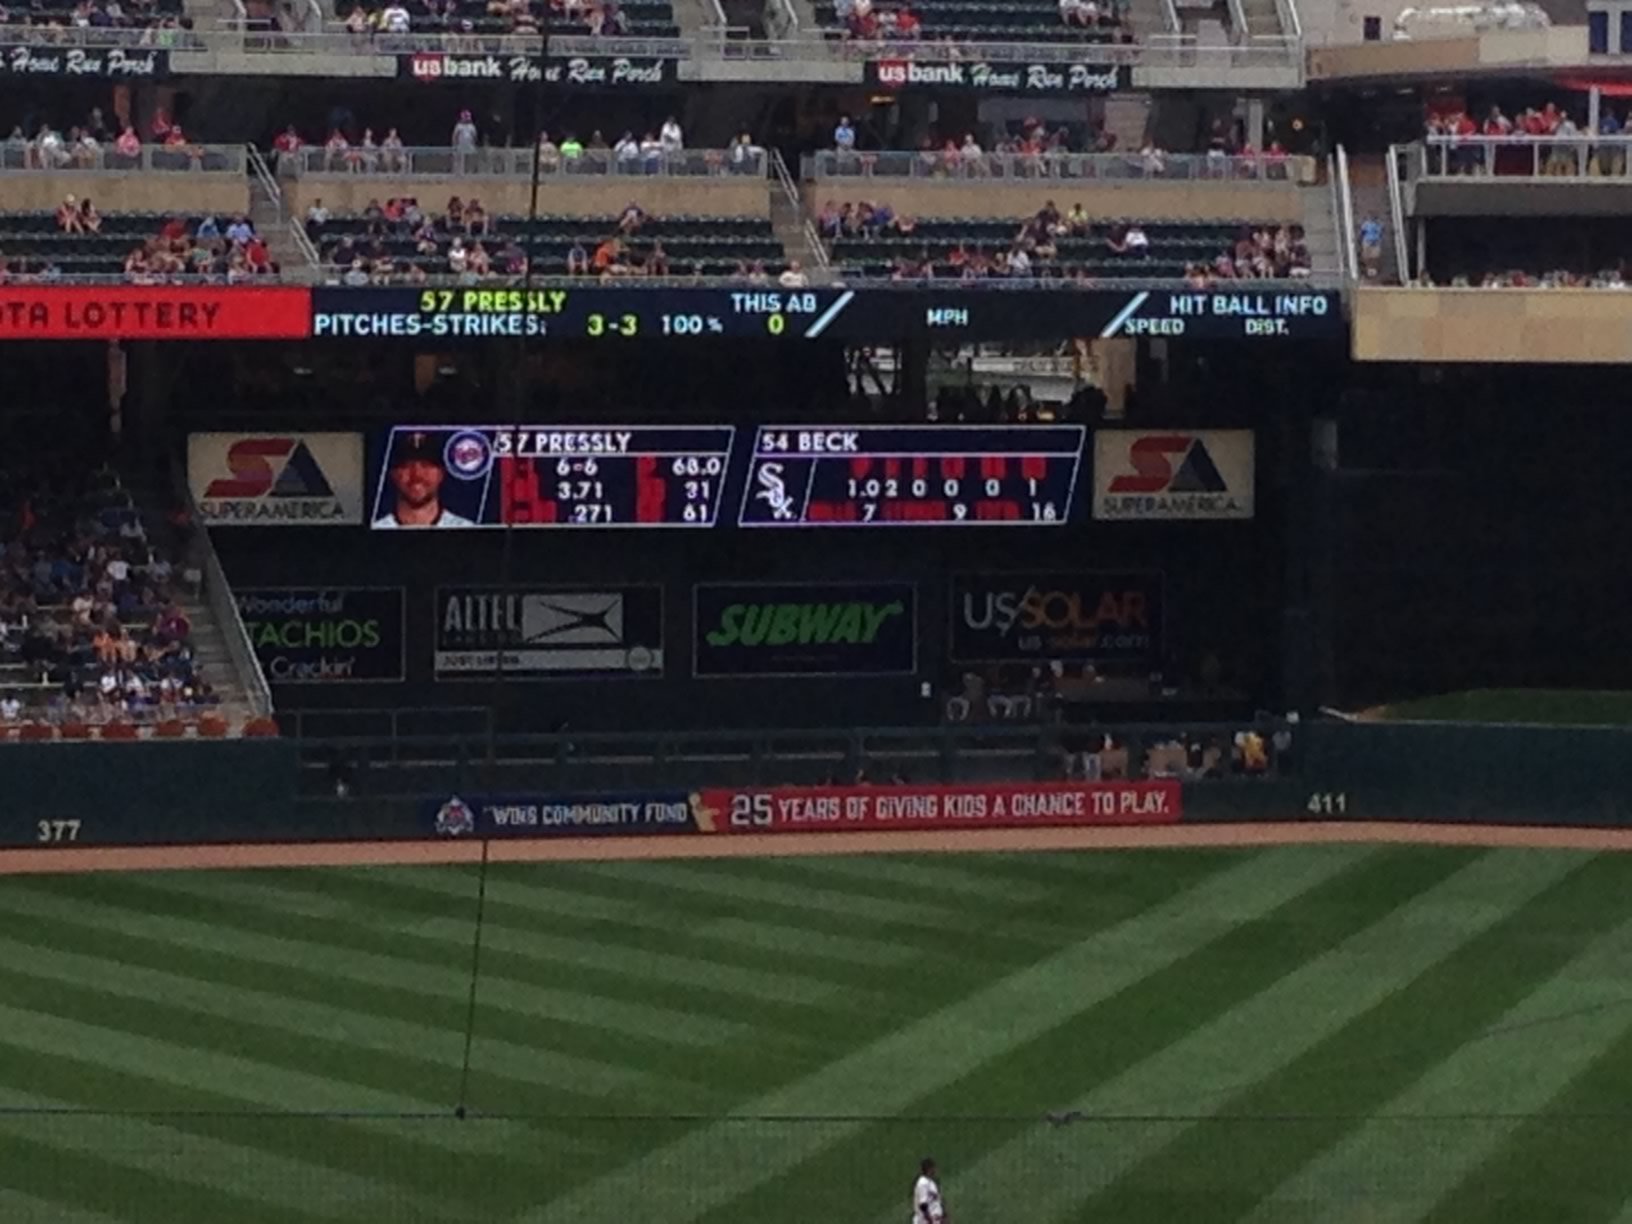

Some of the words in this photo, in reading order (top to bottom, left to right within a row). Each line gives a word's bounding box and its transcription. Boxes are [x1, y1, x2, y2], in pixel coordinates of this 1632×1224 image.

[10, 47, 60, 74] Home
[65, 49, 101, 75] Run
[107, 49, 157, 75] Porch
[567, 57, 606, 82] Run
[611, 58, 662, 83] Porch
[968, 63, 1018, 87] Home
[1025, 64, 1062, 89] Run
[1068, 64, 1118, 91] Porch
[420, 291, 452, 312] 57
[463, 291, 566, 312] PRESSLY
[731, 293, 781, 313] THIS
[786, 293, 817, 313] AB
[1170, 296, 1206, 314] HIT
[1213, 296, 1269, 314] BALL
[1276, 296, 1327, 314] INFO
[64, 302, 220, 329] LOTTERY
[768, 314, 784, 334] 0
[926, 309, 968, 326] MPH
[1125, 318, 1185, 335] SPEED
[499, 433, 528, 452] 57
[535, 433, 632, 452] PRESSLY
[762, 434, 789, 451] 54
[798, 433, 858, 451] BECK
[558, 482, 602, 499] 3.71
[685, 482, 710, 499] 31
[885, 479, 898, 497] 2
[912, 479, 927, 497] 0
[944, 479, 959, 497] 0
[985, 479, 1000, 497] 0
[1028, 479, 1037, 496] 1
[683, 504, 708, 521] 61
[863, 503, 876, 521] 7
[953, 503, 968, 521] 9
[1032, 503, 1056, 521] 16
[706, 601, 904, 646] SUBWAY
[731, 795, 772, 825] 25
[778, 800, 840, 822] YEARS
[846, 798, 870, 820] OF
[876, 796, 937, 819] GIVING
[943, 794, 988, 818] KIDS
[992, 795, 1005, 817] A
[1011, 793, 1085, 816] CHANCE
[1091, 791, 1115, 814] TO
[1120, 791, 1170, 813] PLAY.
[1307, 793, 1346, 813] 411
[542, 804, 638, 824] COMMUNITY
[645, 803, 688, 822] FUND
[37, 819, 81, 841] 377
